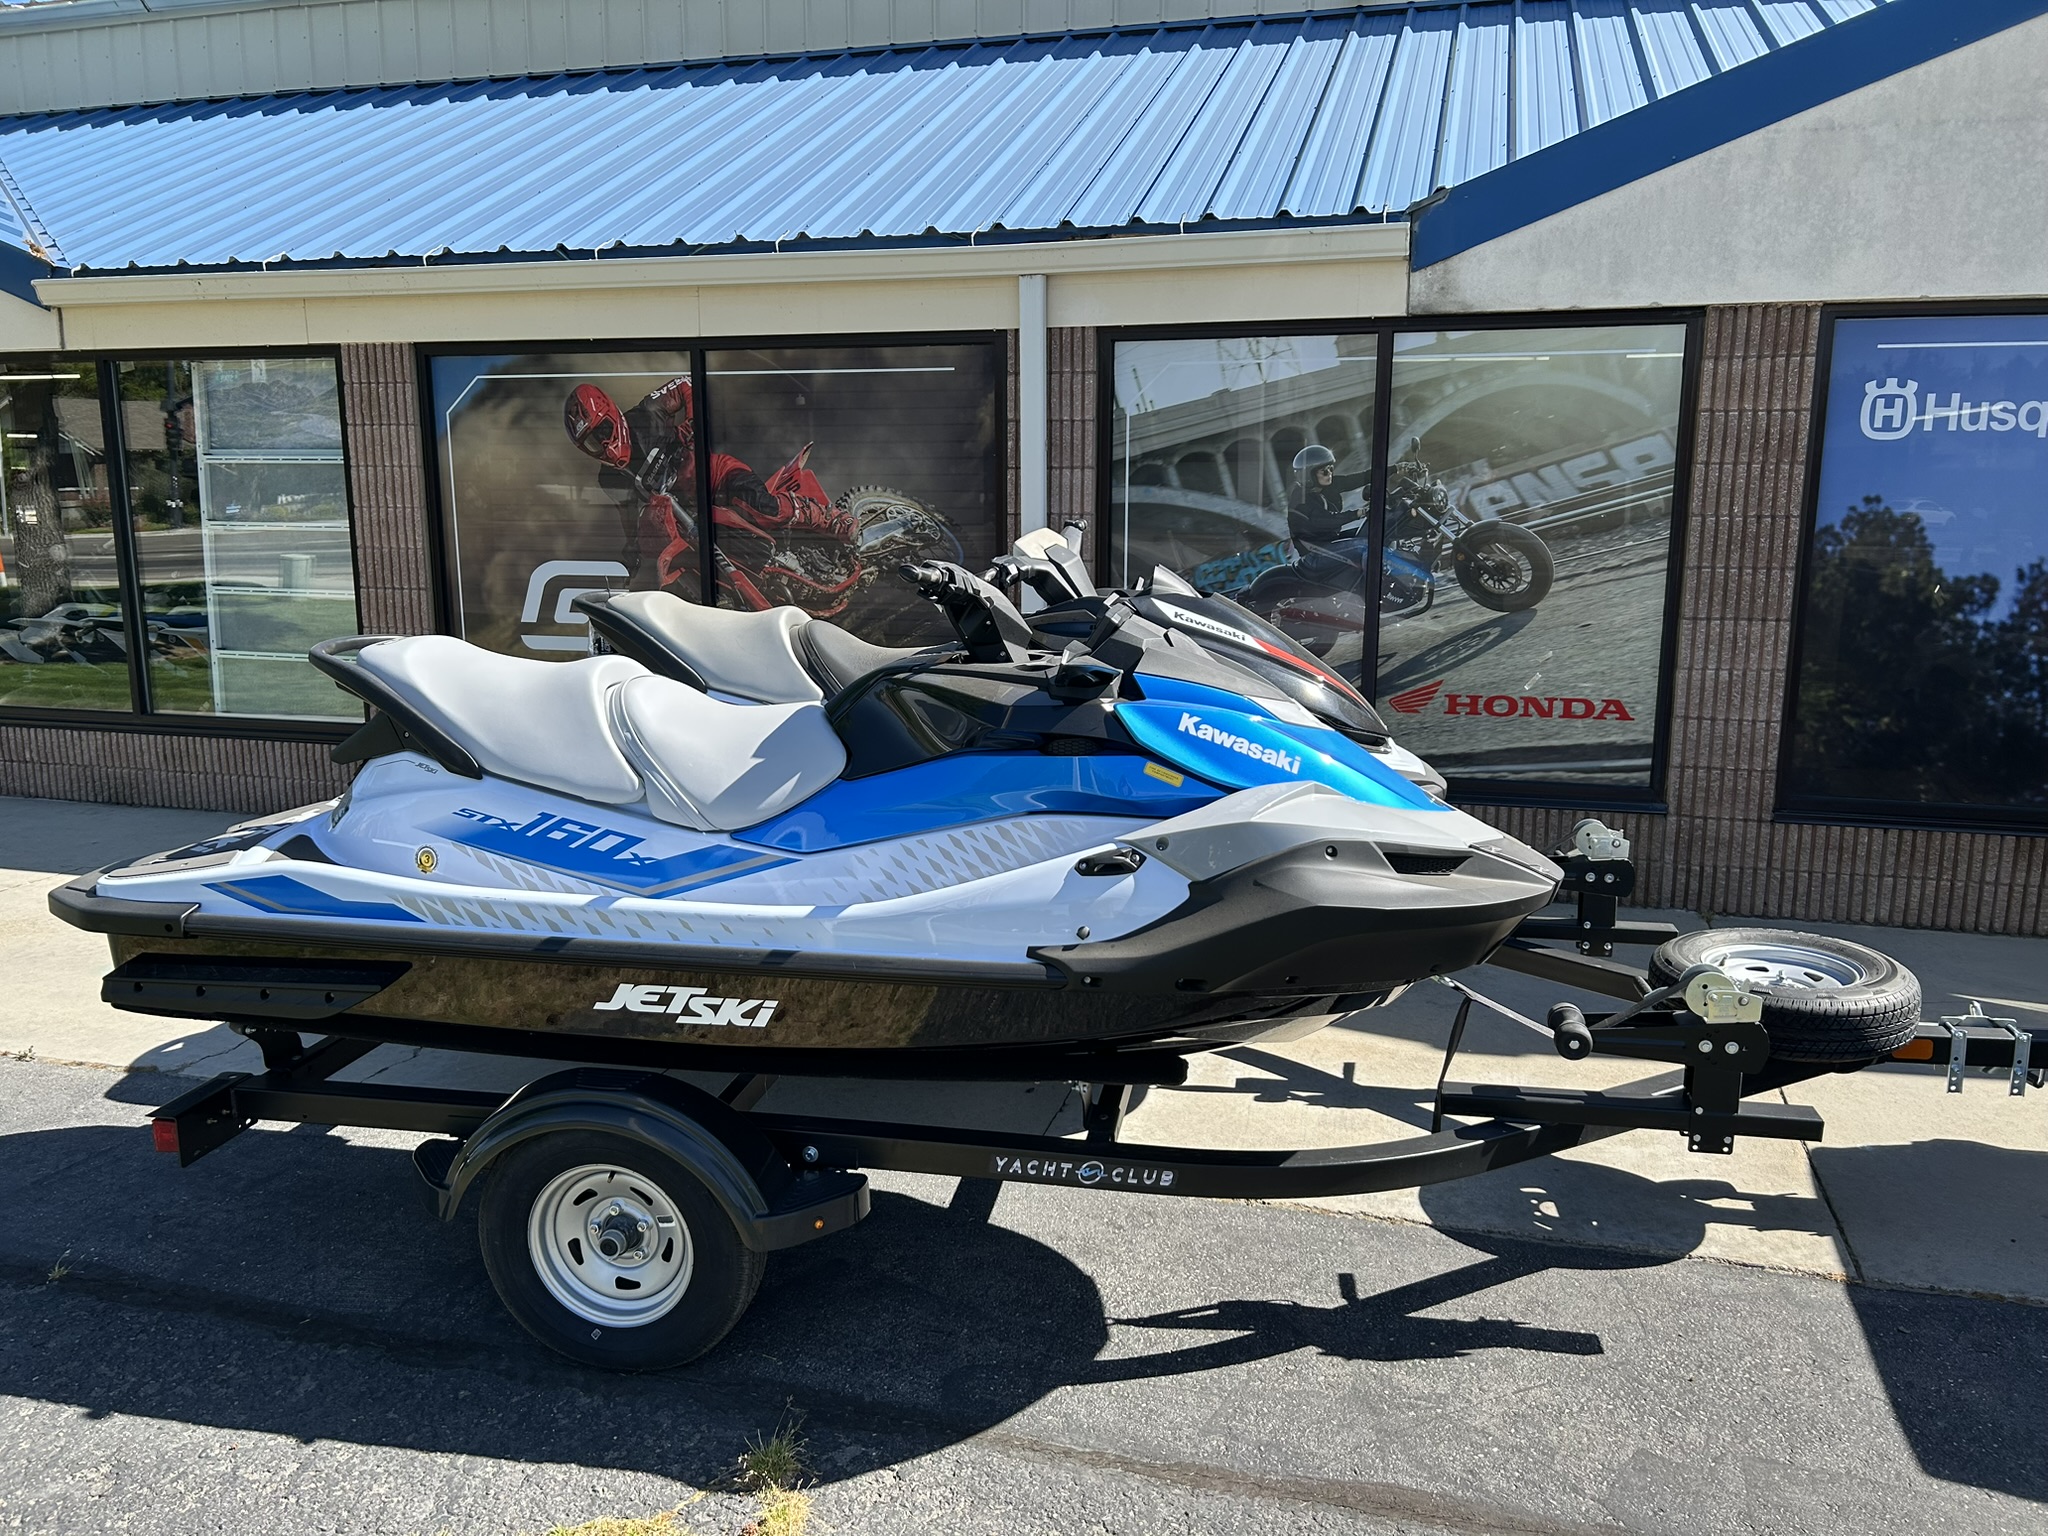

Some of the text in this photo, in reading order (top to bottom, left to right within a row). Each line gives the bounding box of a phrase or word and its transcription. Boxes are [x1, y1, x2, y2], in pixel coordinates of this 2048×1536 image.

[1923, 392, 2048, 438] Husq
[1174, 611, 1246, 642] Kawasaki
[1443, 694, 1635, 721] HONDA
[1178, 712, 1301, 775] Kawasaki
[995, 1156, 1176, 1187] YACHT CLUB
